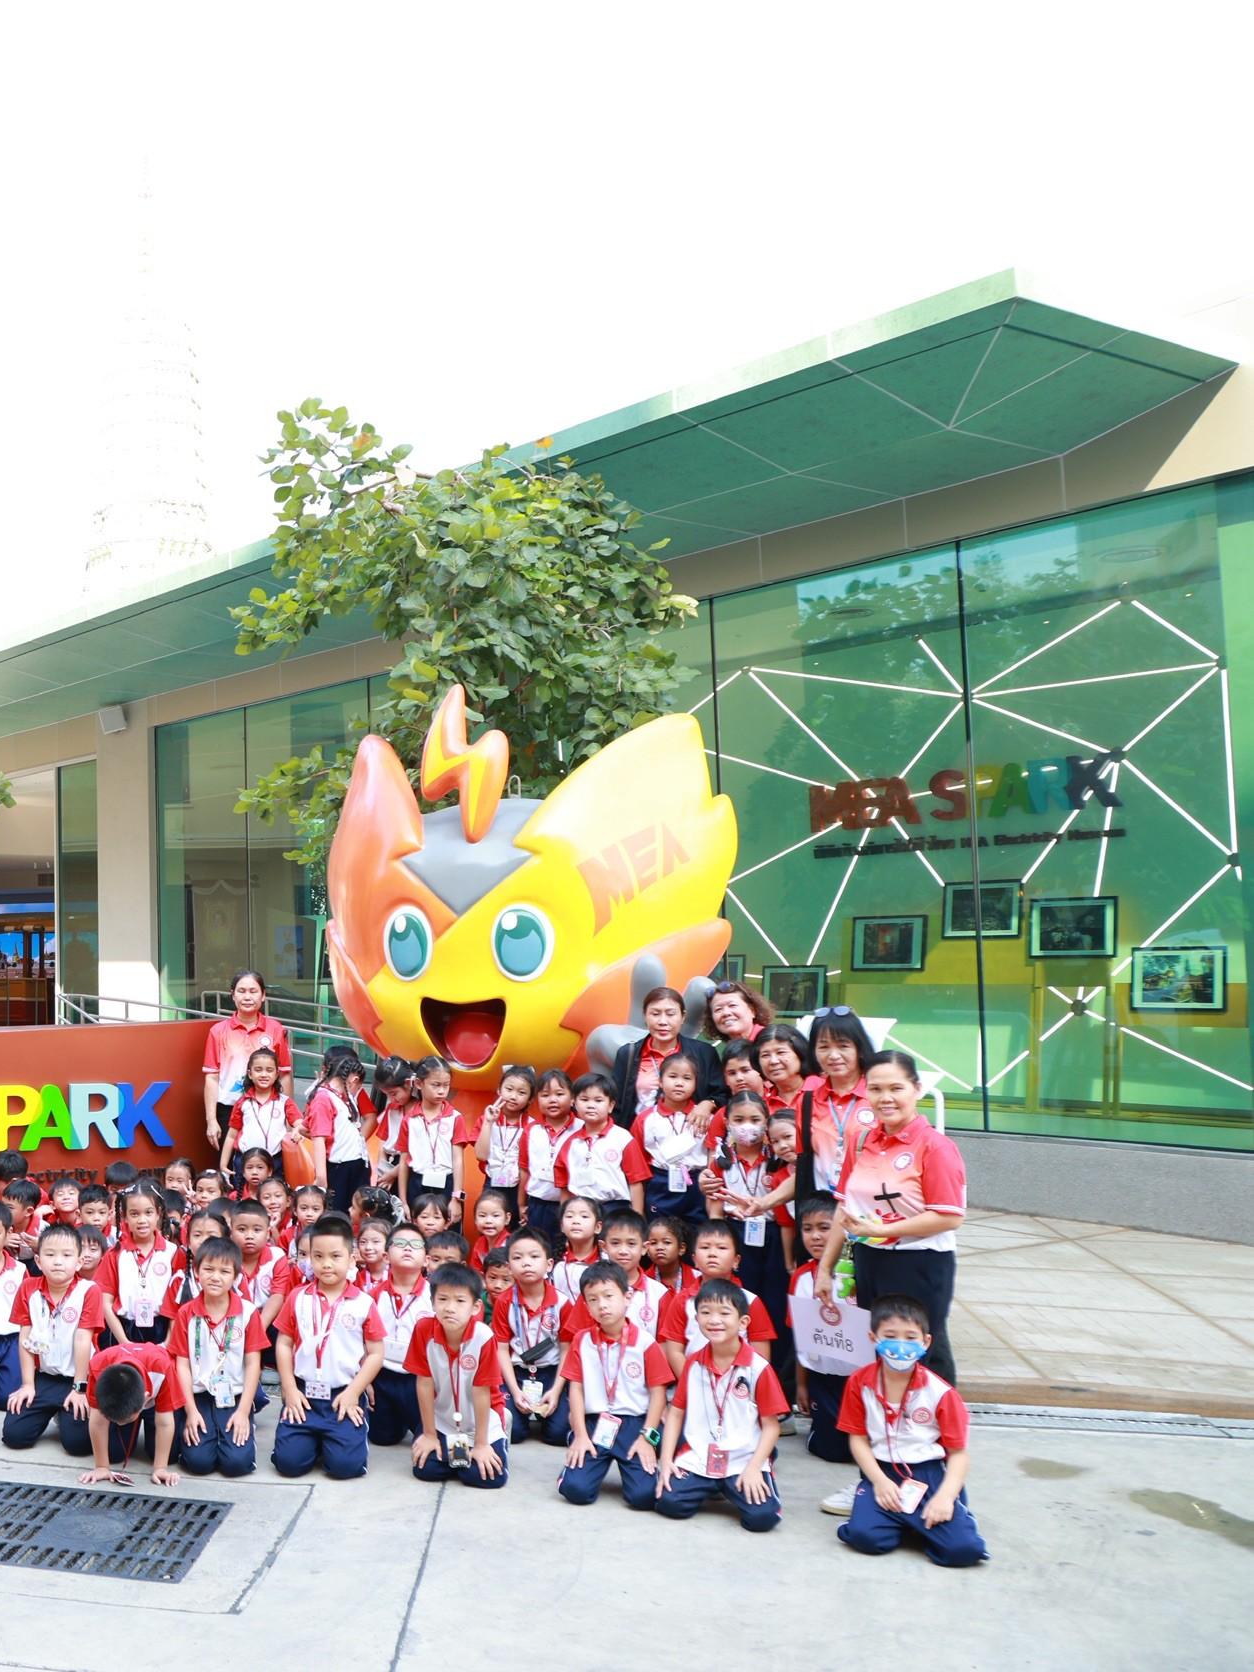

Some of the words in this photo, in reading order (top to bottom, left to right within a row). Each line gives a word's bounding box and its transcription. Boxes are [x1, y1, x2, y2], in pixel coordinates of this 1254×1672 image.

[810, 777, 922, 833] MEA
[929, 754, 1124, 821] SPARK
[576, 823, 690, 938] MEA
